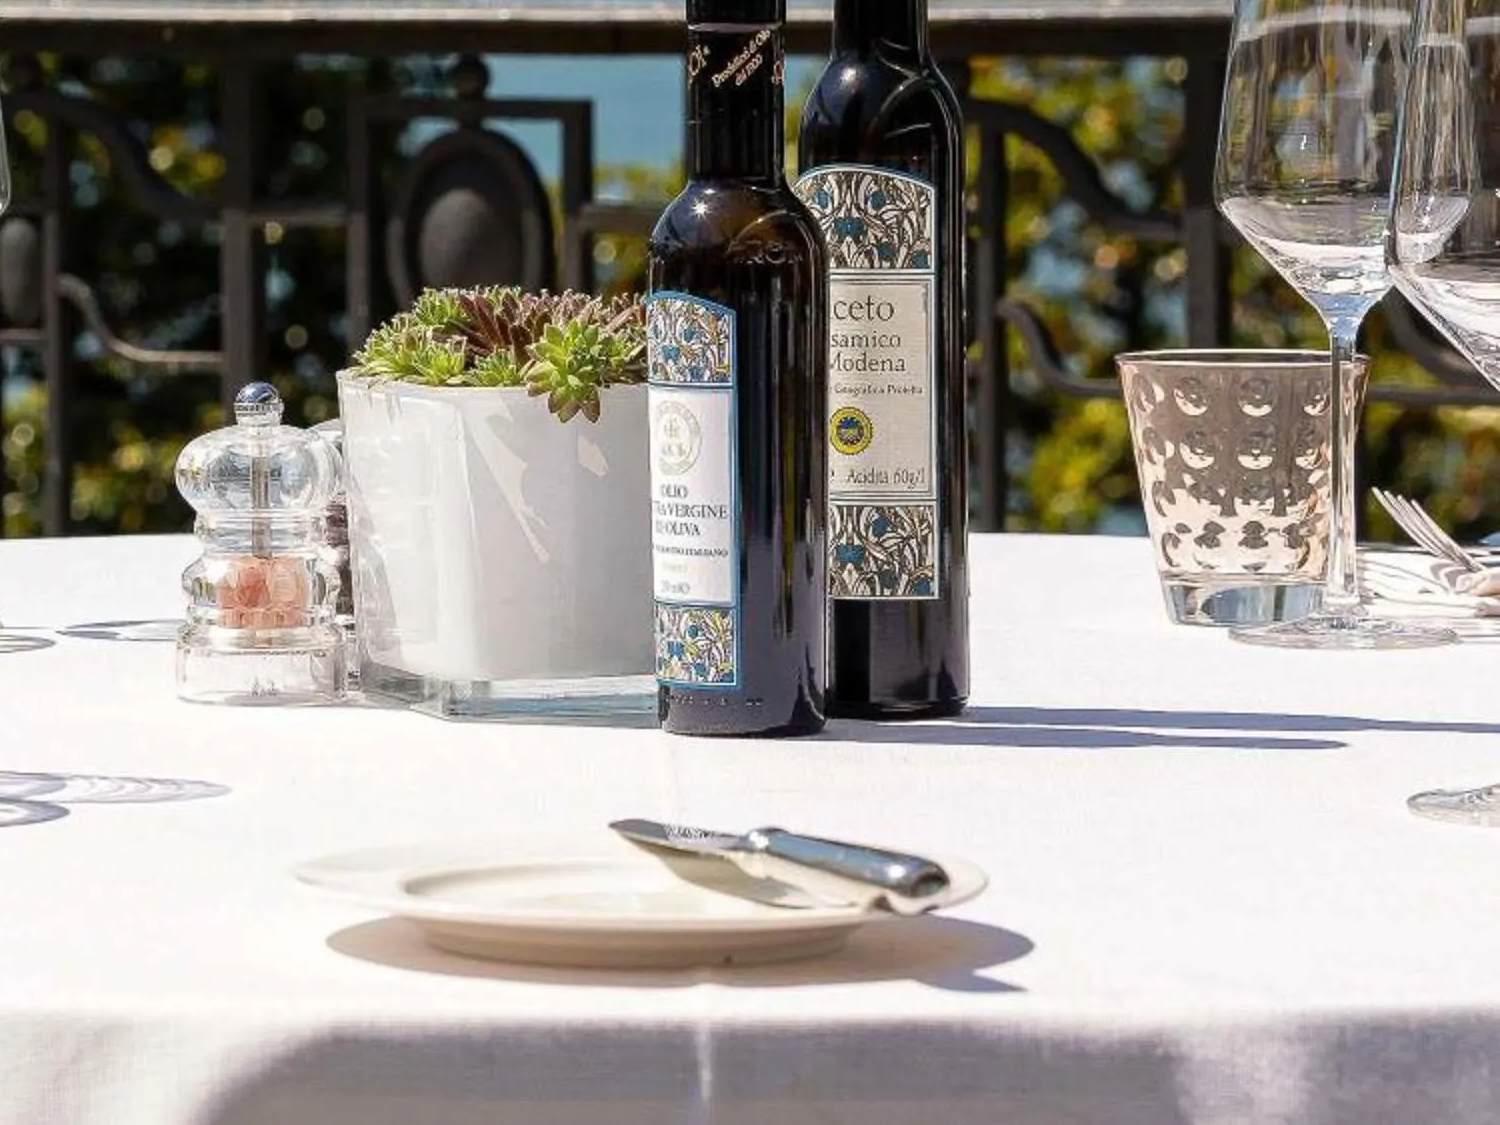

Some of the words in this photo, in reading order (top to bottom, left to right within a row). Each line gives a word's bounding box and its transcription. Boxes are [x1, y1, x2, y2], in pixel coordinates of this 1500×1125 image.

[832, 294, 895, 322] ceto
[830, 329, 901, 348] samico
[667, 502, 729, 520] VERGINE
